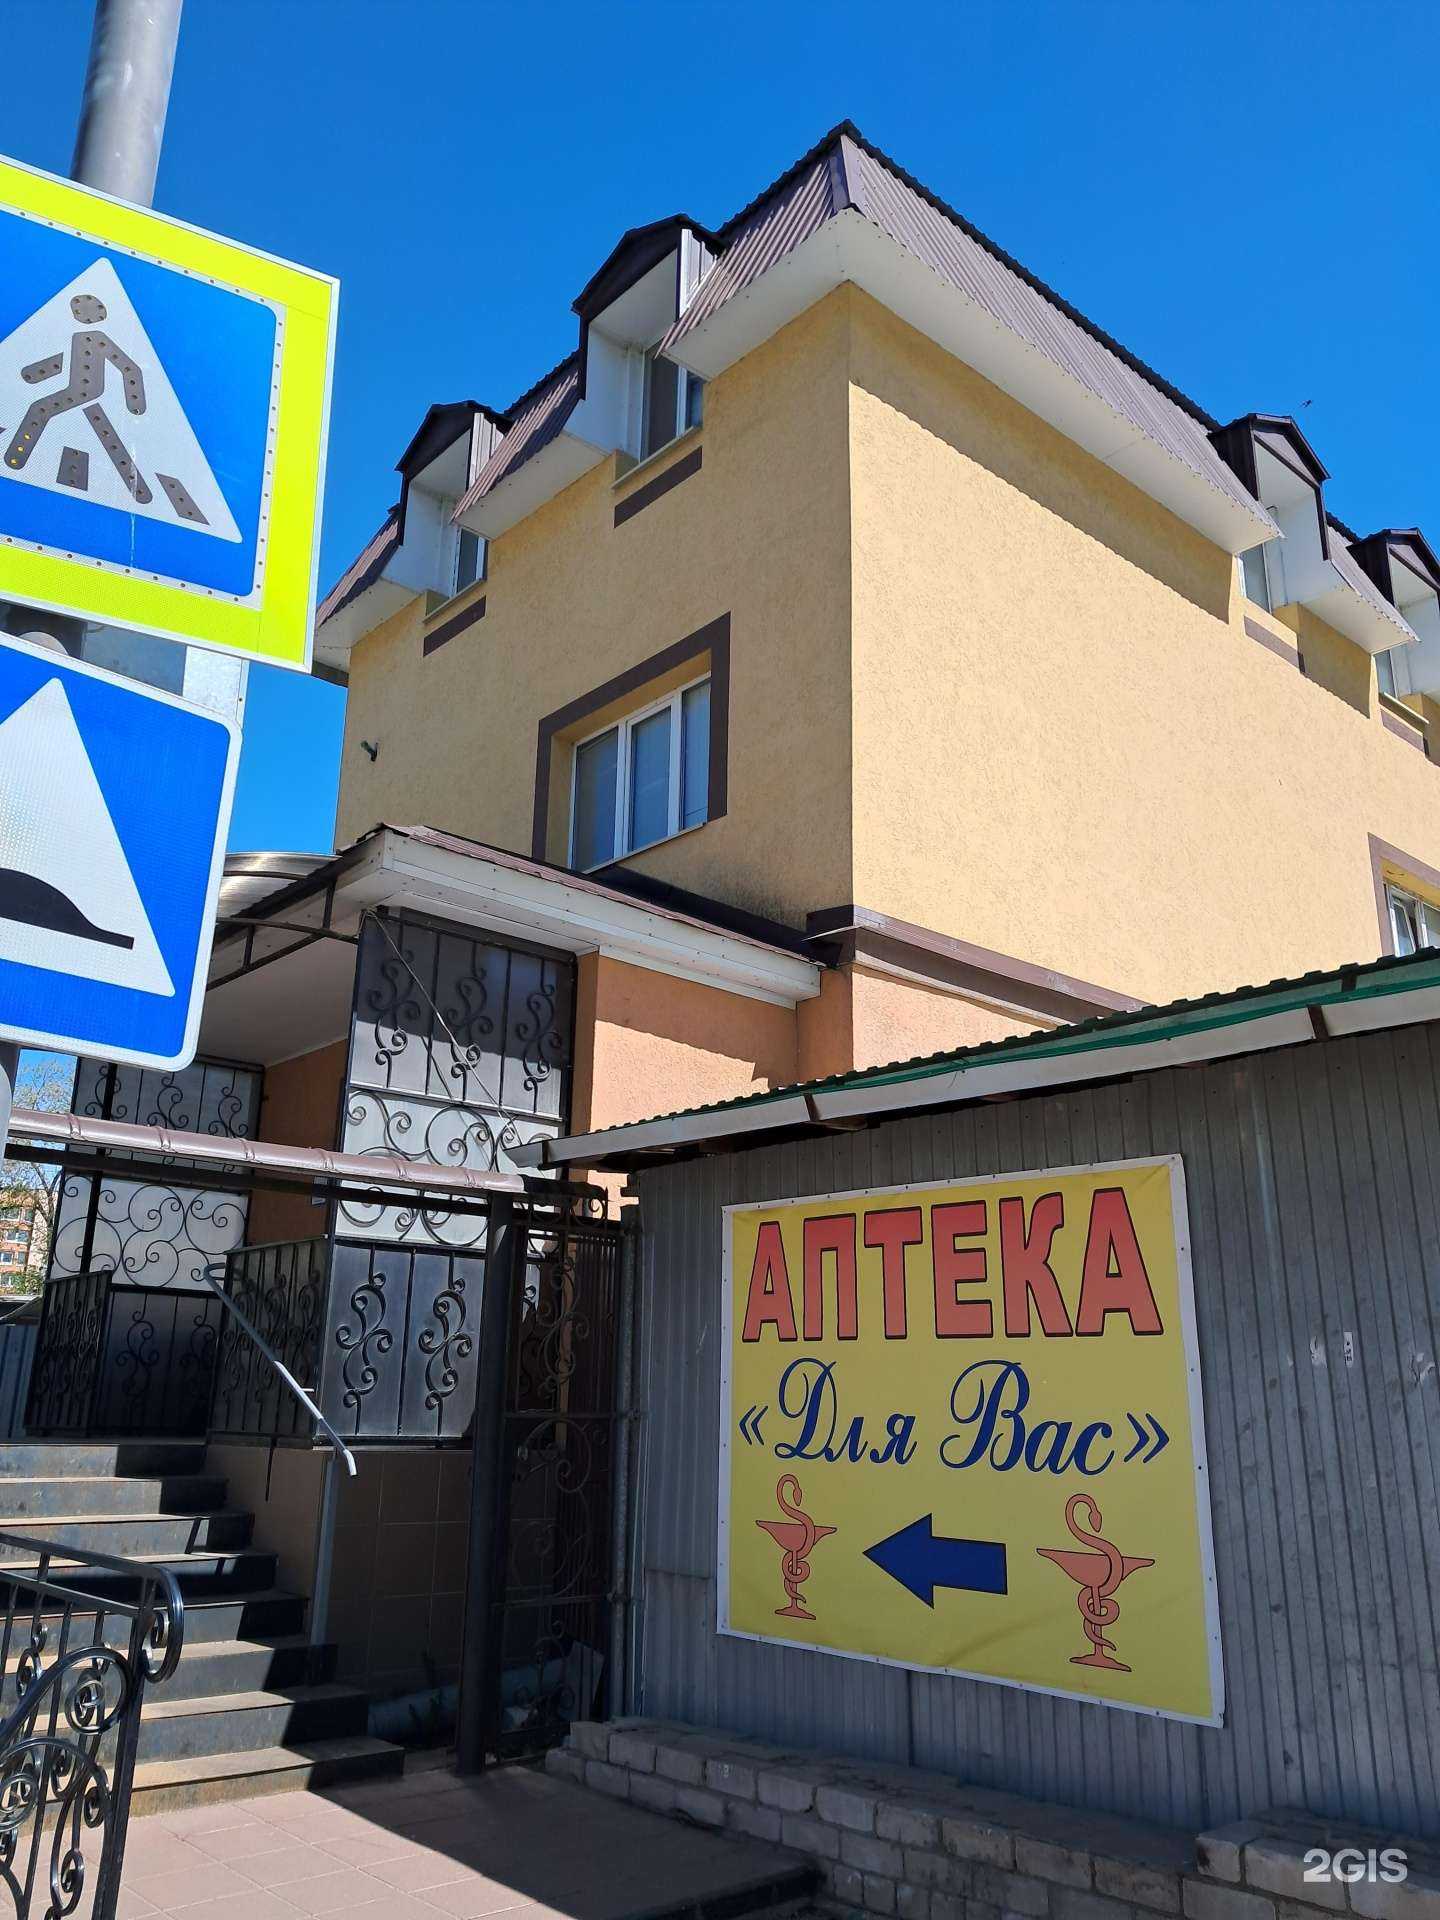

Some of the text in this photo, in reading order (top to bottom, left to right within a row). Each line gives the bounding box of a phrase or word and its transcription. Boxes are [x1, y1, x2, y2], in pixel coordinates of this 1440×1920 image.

[742, 1187, 1164, 1342] АПТЕКА
[738, 1357, 1170, 1475] «Для Вас»
